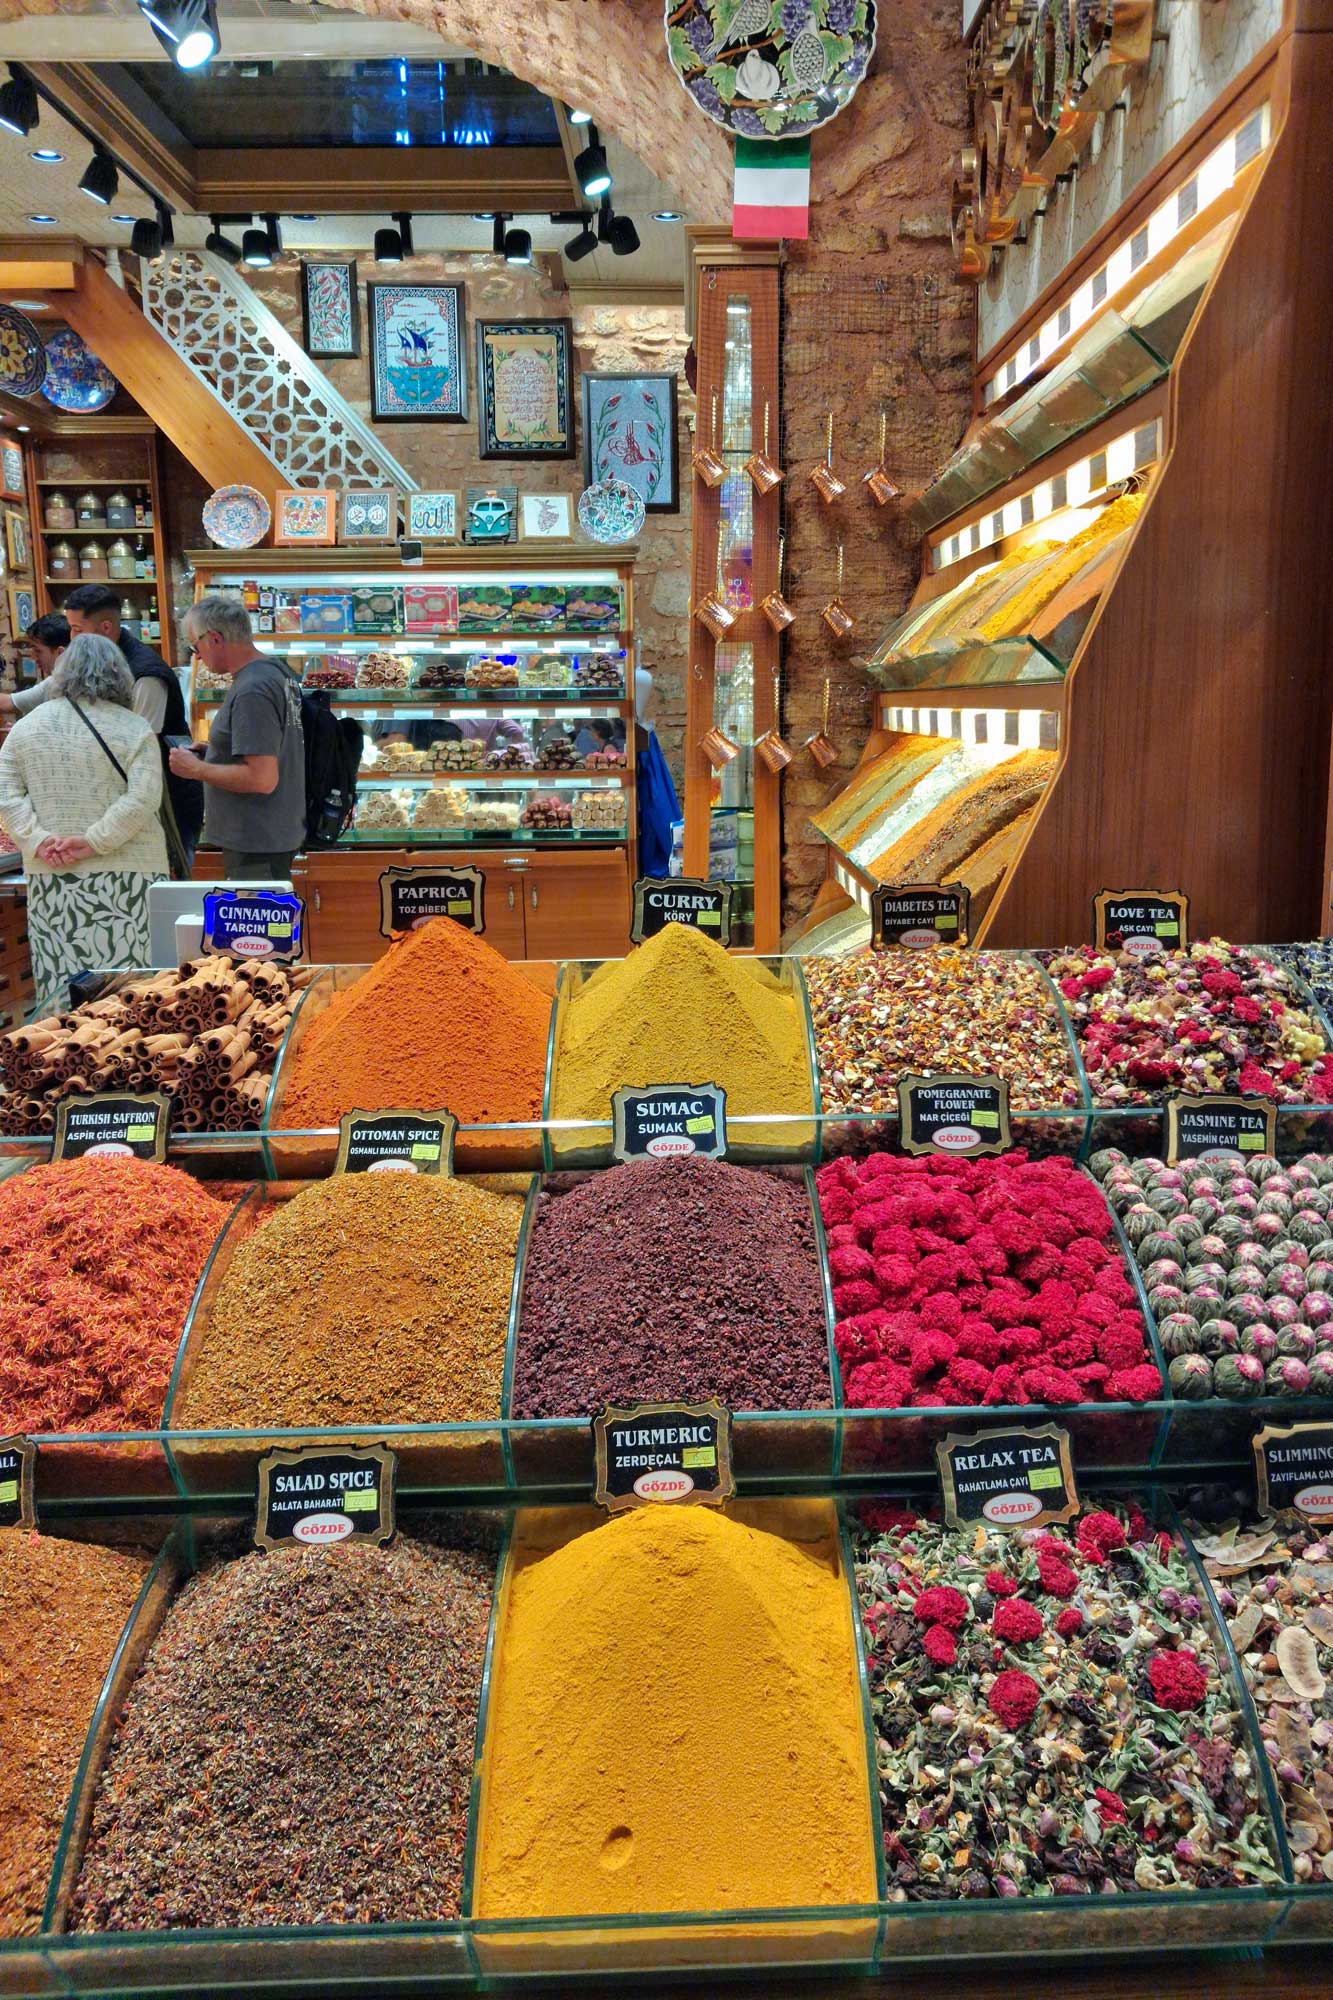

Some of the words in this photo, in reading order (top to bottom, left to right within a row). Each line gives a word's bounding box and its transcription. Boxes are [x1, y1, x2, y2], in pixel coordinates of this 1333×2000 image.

[398, 886, 468, 899] PAPRICA
[648, 893, 718, 910] CURRY
[885, 900, 935, 913] DIABETES
[937, 900, 957, 911] TEA
[219, 906, 291, 923] CINNAMON
[398, 906, 417, 914] TOZ
[418, 904, 447, 914] BİBER
[1110, 908, 1145, 919] LOVE
[1148, 908, 1175, 919] TEA
[664, 910, 692, 922] KÖRY
[885, 916, 916, 926] DİYABET
[917, 916, 934, 926] ÇAYI
[224, 922, 266, 935] TARÇIN
[1136, 925, 1154, 934] ÇAYI
[903, 934, 936, 944] GÖZDE
[236, 941, 269, 951] GÖZDE
[1127, 942, 1158, 951] GÖZDE
[917, 1088, 992, 1099] POMEGRANATE
[636, 1101, 704, 1117] SUMAC
[934, 1099, 976, 1110] FLOWER
[70, 1113, 111, 1126] TURKISH
[113, 1111, 155, 1125] SAFFRON
[919, 1113, 938, 1122] NAR
[940, 1111, 970, 1123] ÇİÇEĞİ
[1180, 1113, 1236, 1128] JASMINE
[1239, 1115, 1264, 1129] TEA
[638, 1122, 683, 1134] SUMAK
[67, 1130, 95, 1141] ASPİR
[96, 1129, 126, 1140] ÇİÇEĞİ
[352, 1130, 405, 1141] OTTOMAN
[407, 1130, 439, 1141] SPICE
[938, 1133, 975, 1143] GÖZDE
[1181, 1132, 1218, 1145] YASEMİN
[1219, 1134, 1237, 1146] ÇAYI
[350, 1147, 379, 1155] OSMANLI
[379, 1147, 411, 1155] BAHARATI
[652, 1141, 689, 1152] GÖZDE
[612, 1426, 712, 1447] TURMERIC
[0, 1456, 17, 1469] LL
[615, 1454, 680, 1468] ZERDEÇAL
[954, 1451, 1015, 1471] RELAX
[1018, 1447, 1057, 1463] TEA
[275, 1473, 325, 1493] SALAD
[328, 1470, 375, 1489] SPICE
[1271, 1471, 1318, 1483] ZAYIFLAMA
[641, 1480, 687, 1493] GÖZDE
[958, 1479, 1008, 1493] RAHATLAMA
[1009, 1476, 1029, 1489] ÇAYI
[272, 1500, 303, 1512] SALATA
[303, 1498, 344, 1510] BAHARATI
[990, 1502, 1035, 1516] GÖZDE
[300, 1523, 346, 1536] GÖZDE
